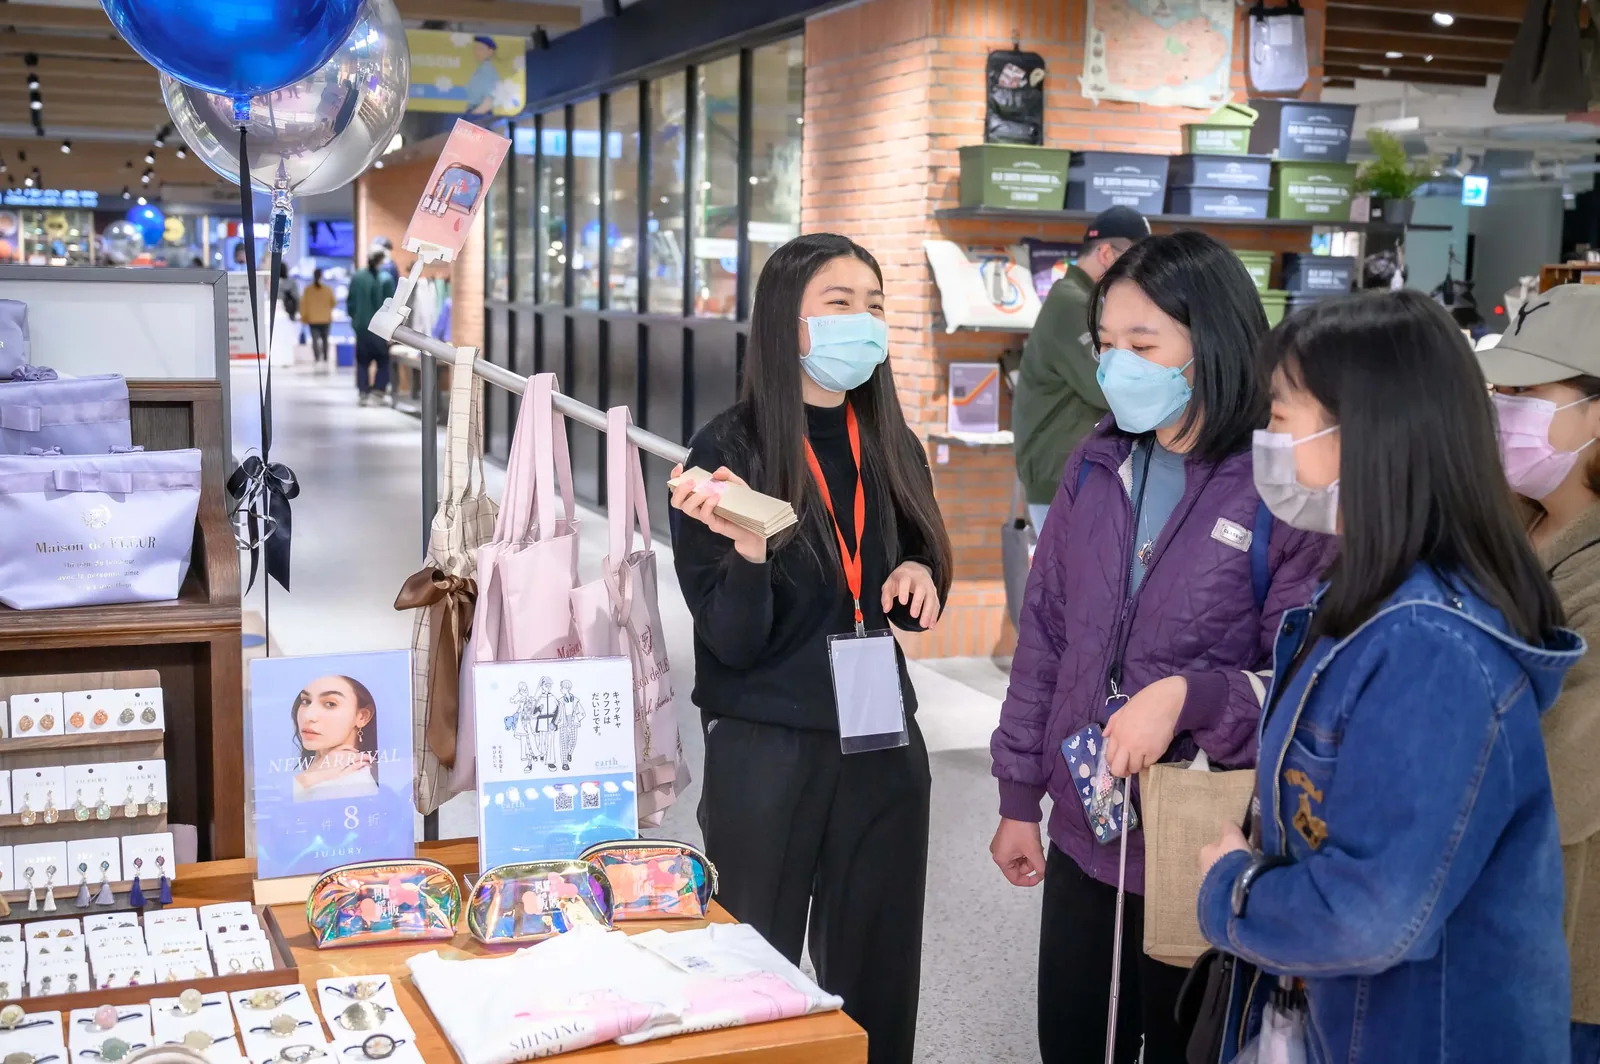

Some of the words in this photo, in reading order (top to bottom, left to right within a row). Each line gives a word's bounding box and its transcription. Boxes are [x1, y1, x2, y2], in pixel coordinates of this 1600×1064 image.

[35, 541, 84, 554] Maison
[602, 692, 611, 725] ウフフは
[612, 691, 621, 728] キャッキャ
[269, 756, 315, 774] NEW
[319, 748, 402, 770] ARRIVAL
[594, 757, 619, 767] earth
[314, 847, 363, 859] JUJURY
[509, 1021, 585, 1053] SHINING
